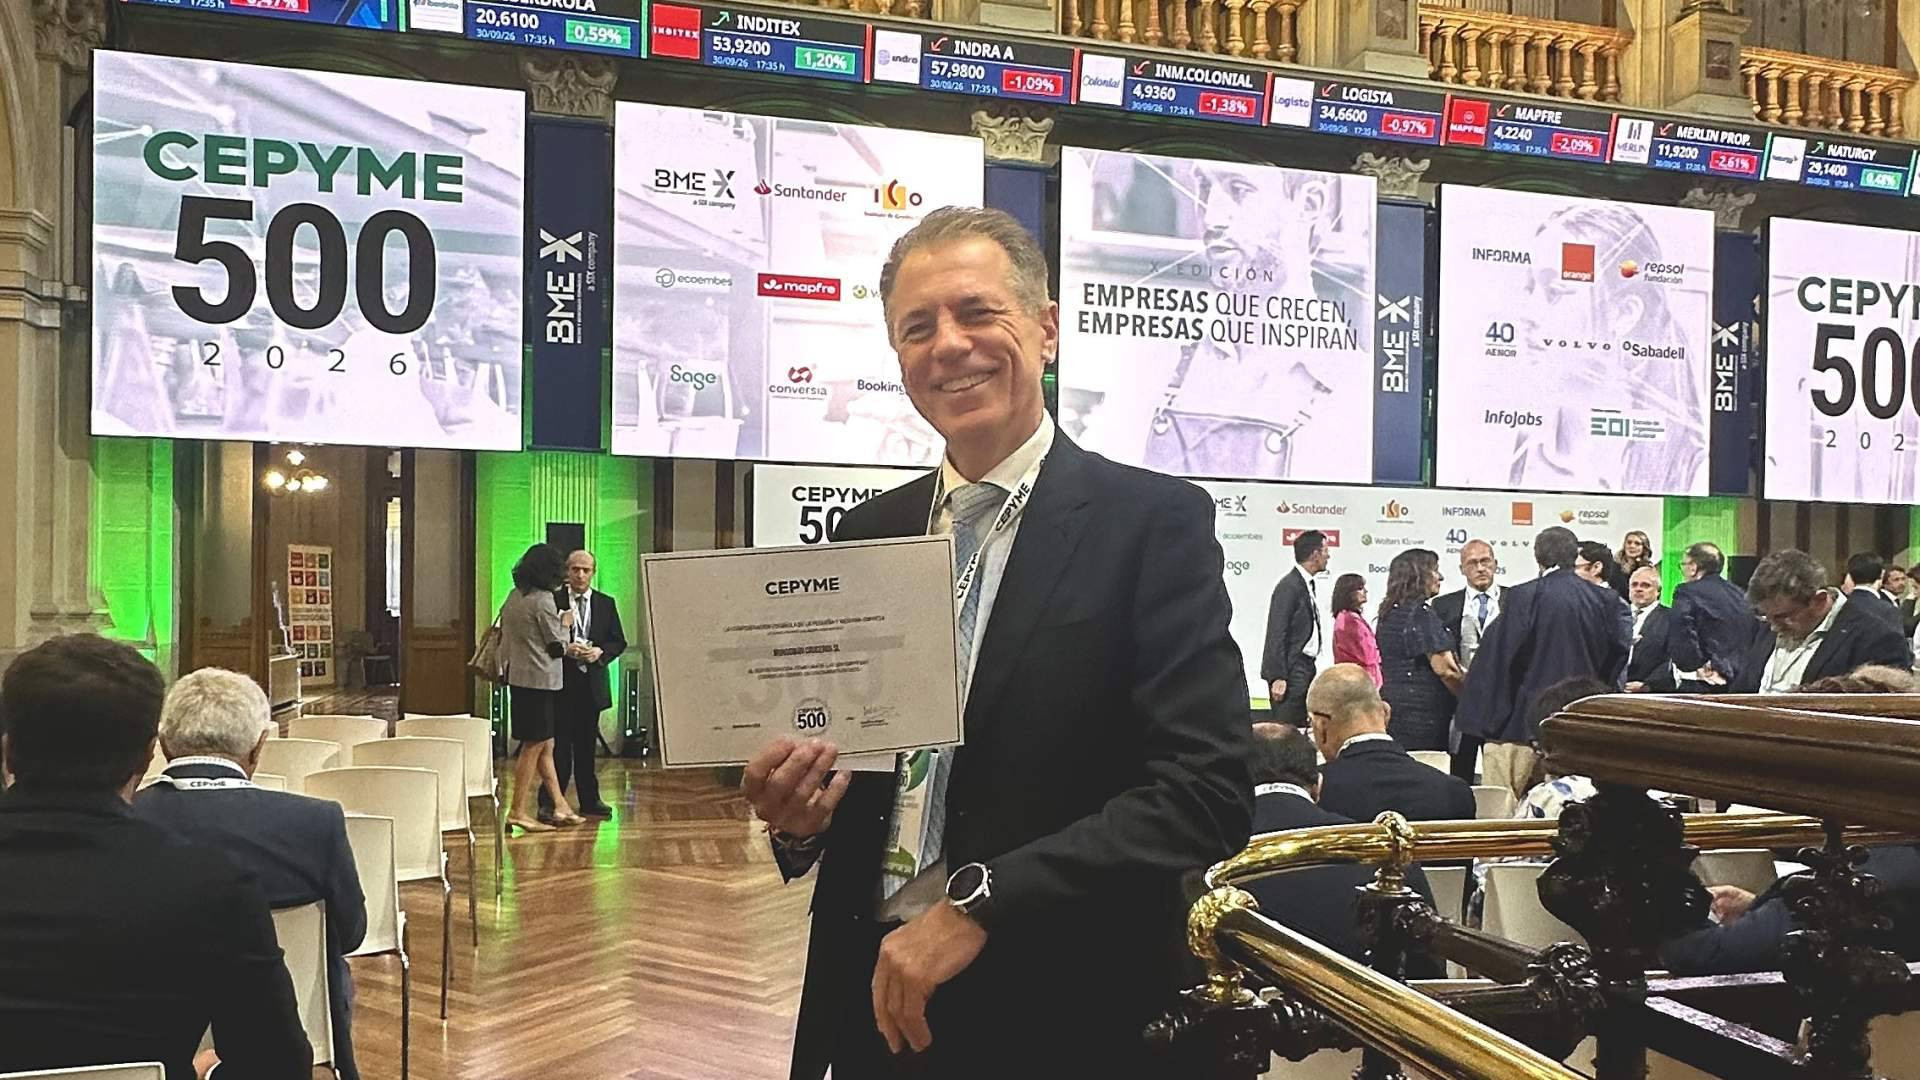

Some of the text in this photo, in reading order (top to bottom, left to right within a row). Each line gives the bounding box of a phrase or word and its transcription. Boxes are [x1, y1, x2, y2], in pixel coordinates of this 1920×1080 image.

[475, 8, 540, 30] 20,6100
[736, 14, 801, 37] INDITEX
[476, 28, 556, 46] 30/09/26 17:35 h
[574, 25, 622, 45] 0,59%
[653, 26, 699, 40] INDITEX
[712, 35, 771, 56] 53,9200
[953, 40, 1015, 61] INDRA A
[712, 55, 786, 72] 30/09/26 17:35 h
[804, 51, 848, 71] 1,20%
[930, 60, 985, 81] 57,9800
[1154, 63, 1254, 89] INM.COLONIAL
[971, 83, 991, 94] 17:35
[1009, 75, 1055, 93] -1,09%
[1082, 74, 1121, 89] Colonial
[1132, 82, 1177, 101] 4,9360
[1341, 86, 1394, 105] LOGISTA
[1205, 98, 1248, 115] -1,38%
[1320, 105, 1368, 123] 34,6600
[1515, 106, 1563, 125] MAPFRE
[1388, 118, 1427, 135] -0,97%
[1450, 122, 1486, 135] MAPFRE
[1494, 126, 1533, 142] 4,2240
[1676, 126, 1751, 146] MERLIN PROP.
[1558, 138, 1594, 153] -2,09%
[1658, 143, 1700, 160] 11,9200
[1827, 144, 1877, 161] NATURGY
[143, 130, 464, 203] CEPYME
[1715, 155, 1750, 170] -2,61%
[1808, 161, 1848, 177] 29,1400
[655, 168, 706, 192] BME
[774, 183, 848, 202] Santander
[171, 195, 437, 335] 500
[1472, 247, 1532, 265] INFORMA
[1150, 261, 1159, 273] X
[1562, 270, 1593, 281] orange
[1644, 261, 1685, 275] repsol
[677, 273, 733, 287] ecoembes
[783, 281, 837, 295] mapfre
[546, 271, 575, 344] BME
[1083, 282, 1352, 328] EMPRESAS QUE CRECEN,
[1078, 310, 1358, 351] EMPRESAS QUE INSPIRAN
[1485, 321, 1515, 343] 40
[1543, 338, 1612, 351] VOLVO
[1382, 329, 1405, 393] BME
[670, 364, 717, 391] Sage
[1810, 323, 1920, 420] 50
[768, 384, 828, 396] conversia
[1714, 353, 1734, 412] BME
[995, 482, 1031, 532] CEPYME
[1292, 503, 1347, 516] Santander
[1442, 507, 1486, 518] INFORMA
[1578, 509, 1610, 519] repsol
[799, 505, 848, 545] 50
[1446, 528, 1468, 544] 40
[957, 552, 978, 600] CEPYM
[1226, 561, 1250, 576] age
[765, 577, 840, 596] CEPYME
[797, 712, 827, 730] 500
